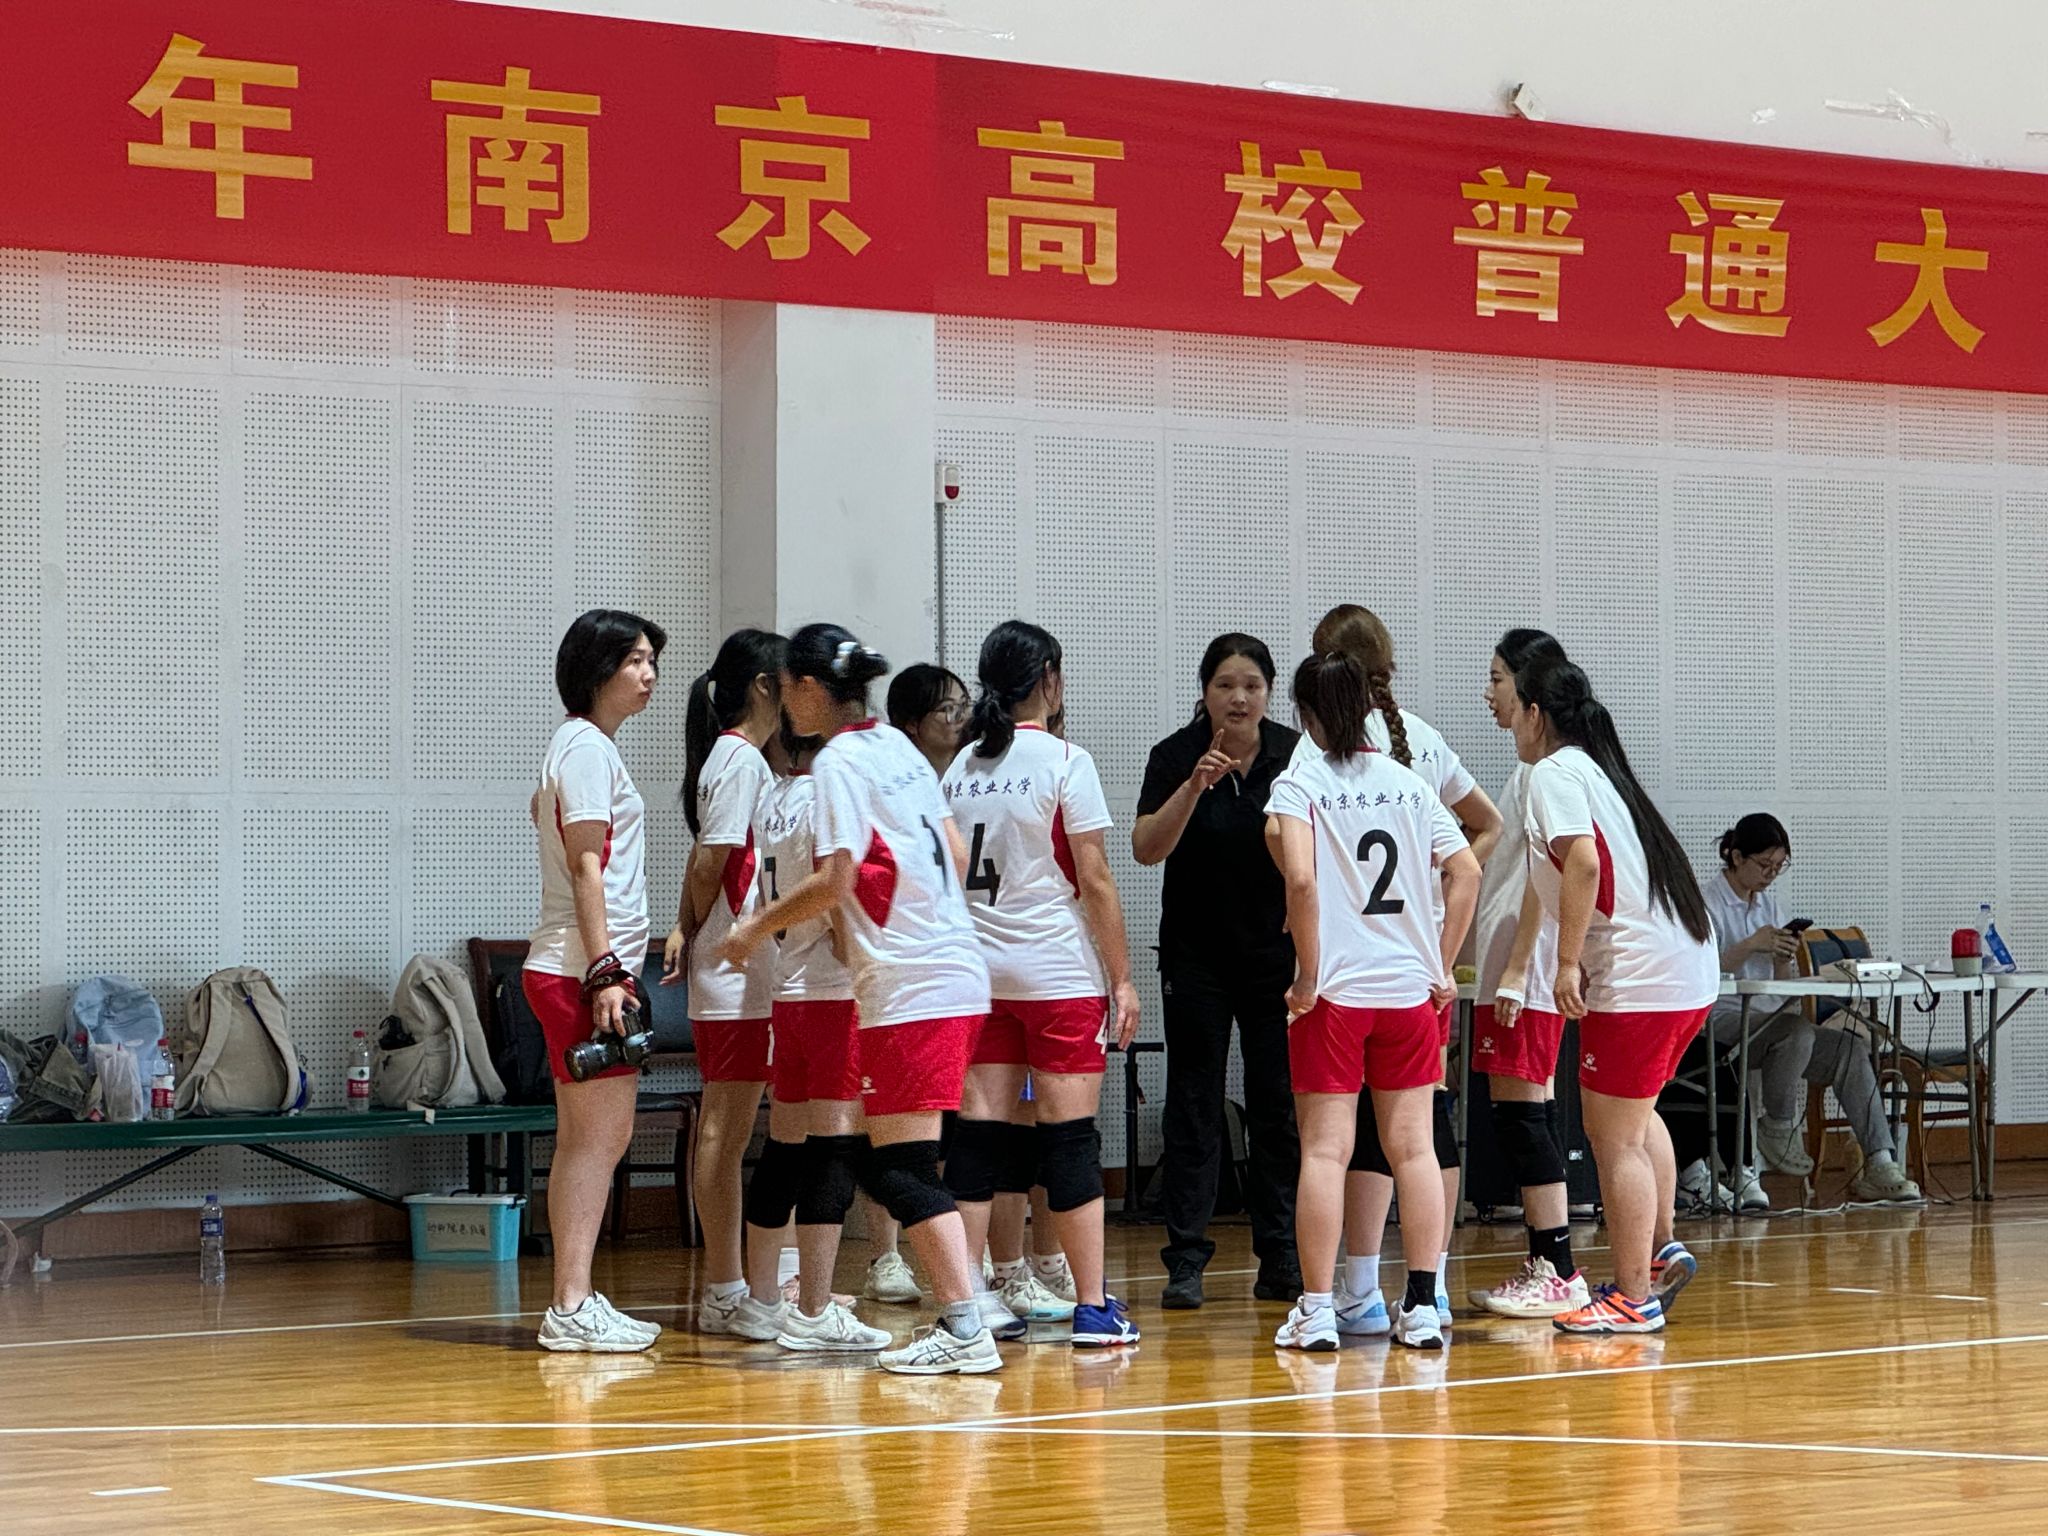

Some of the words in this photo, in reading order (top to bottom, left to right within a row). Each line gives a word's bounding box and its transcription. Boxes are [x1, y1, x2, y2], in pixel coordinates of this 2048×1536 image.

[128, 33, 1990, 355] 年南京高校普通大
[1318, 791, 1422, 811] 南京农业大学
[966, 823, 1001, 906] 4
[1356, 829, 1405, 915] 2
